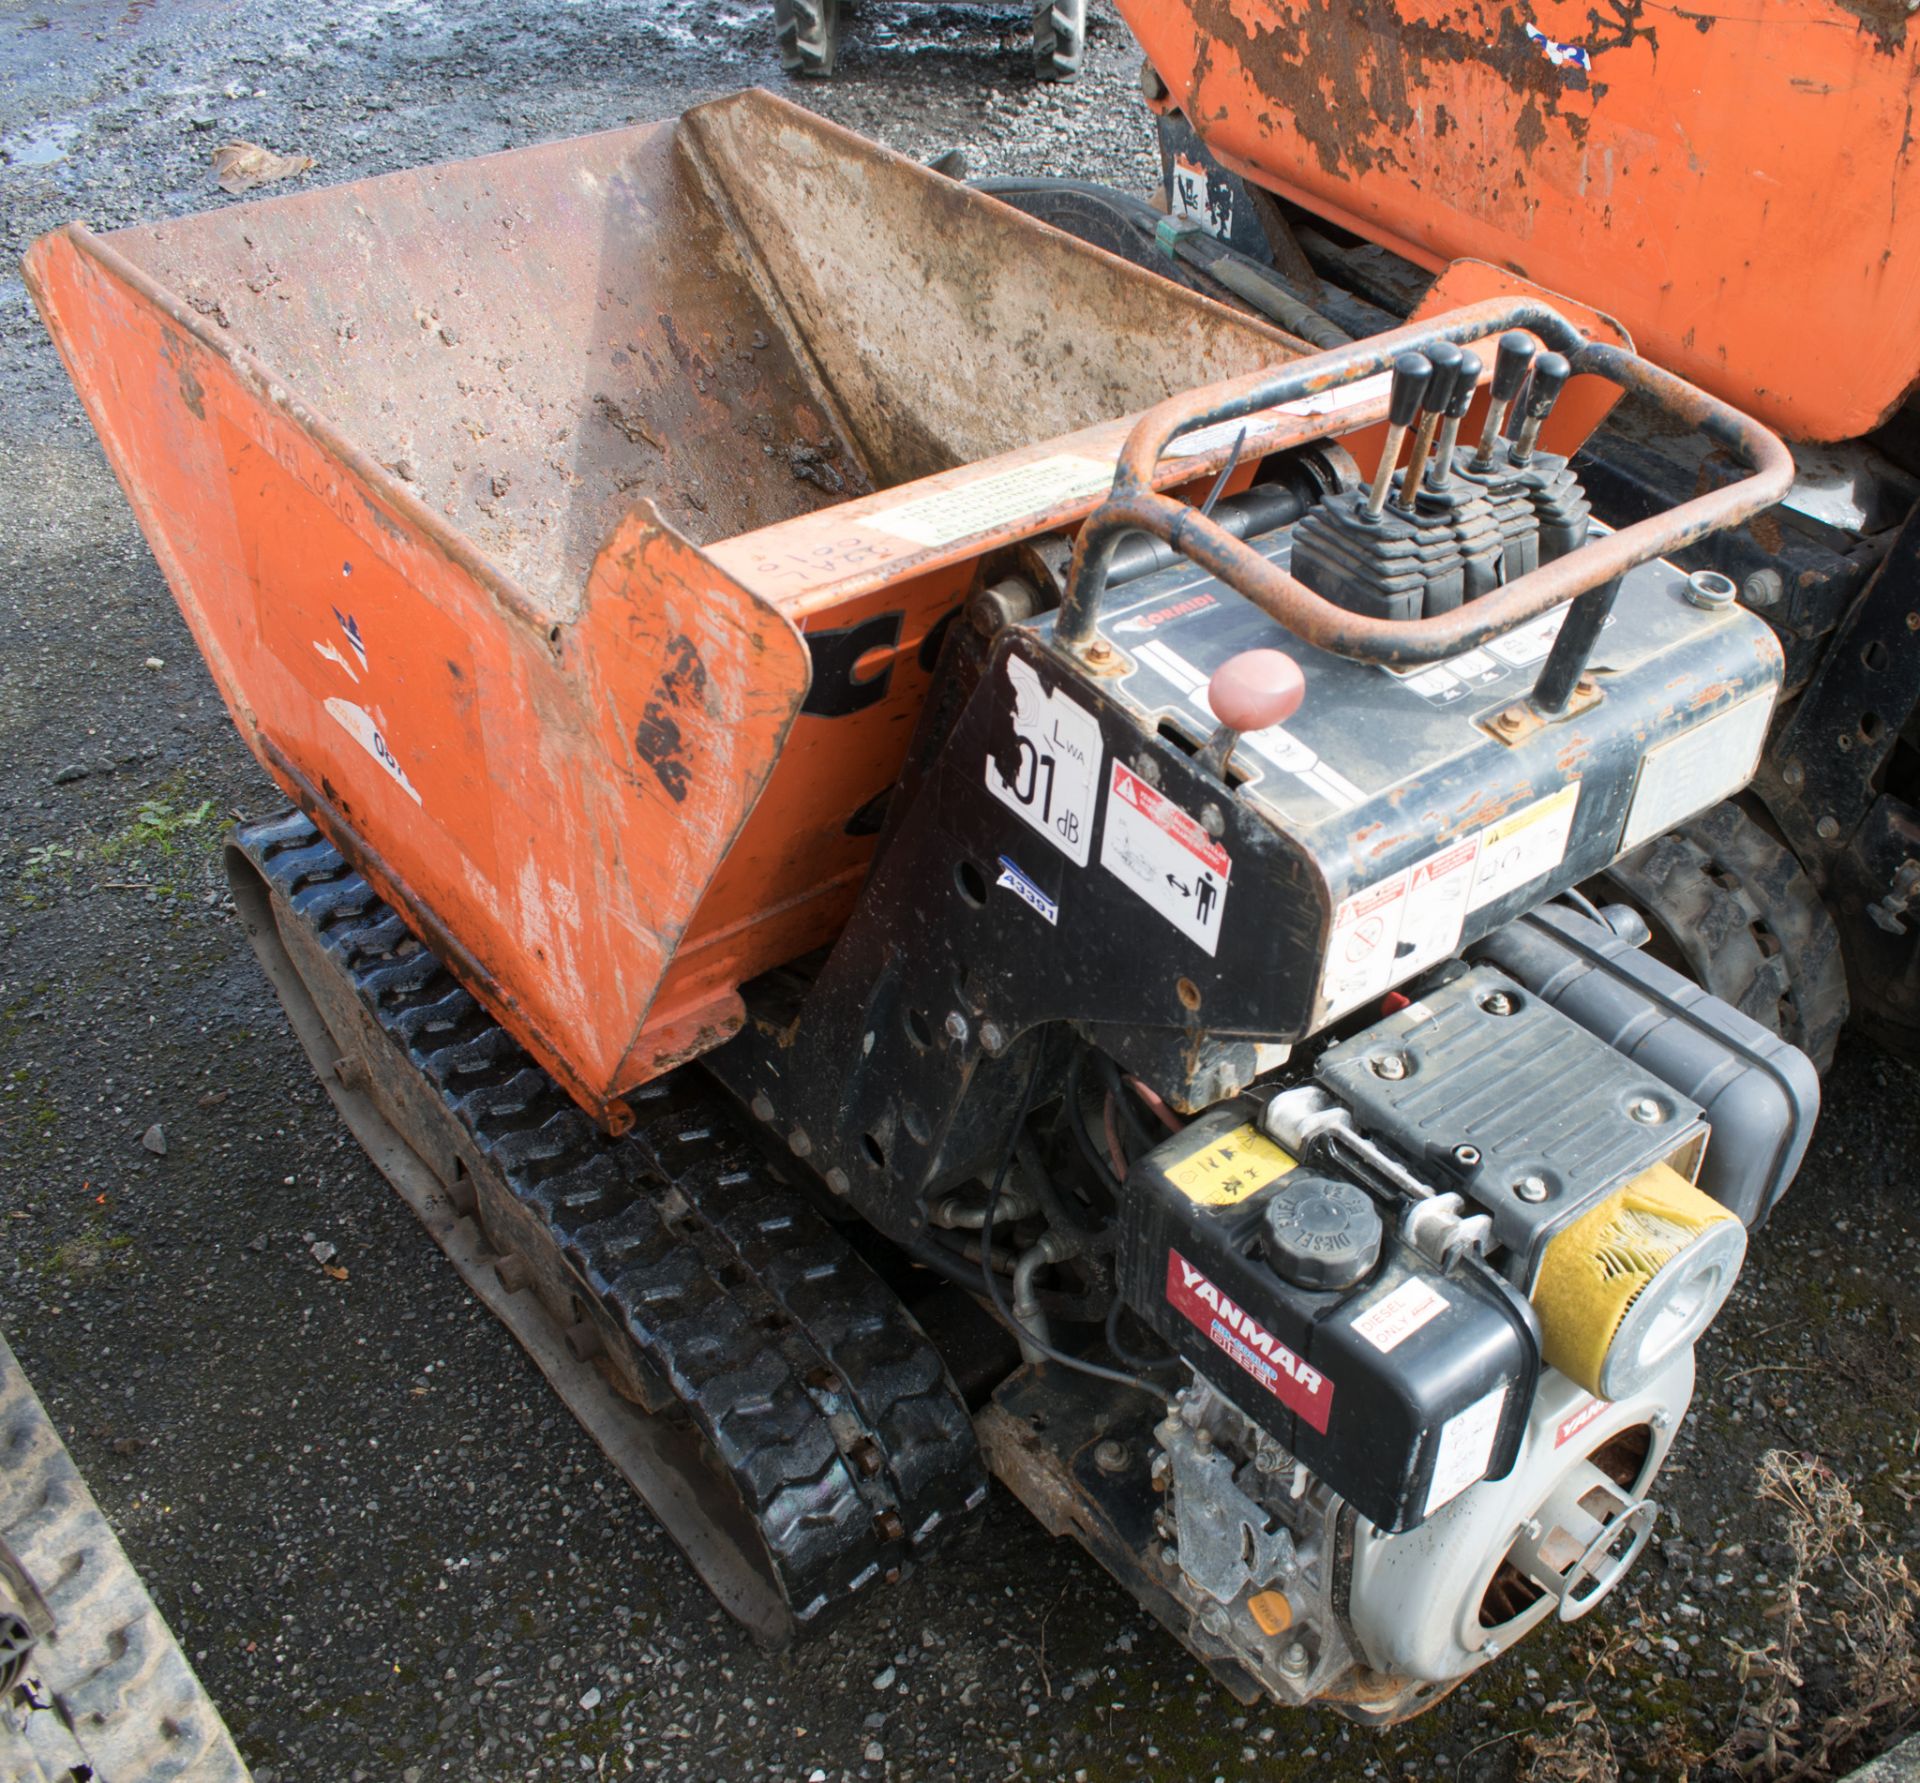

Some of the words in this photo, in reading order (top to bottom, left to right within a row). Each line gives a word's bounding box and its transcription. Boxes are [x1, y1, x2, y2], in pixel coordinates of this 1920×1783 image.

[1003, 734, 1056, 825] 01
[1057, 808, 1079, 845] dB
[1294, 1229, 1351, 1252] DIESEL
[1180, 1259, 1323, 1395] YANMAR
[1361, 1299, 1406, 1332] DIESEL
[1376, 1315, 1409, 1343] ONLY
[1210, 1327, 1277, 1394] DIESEL
